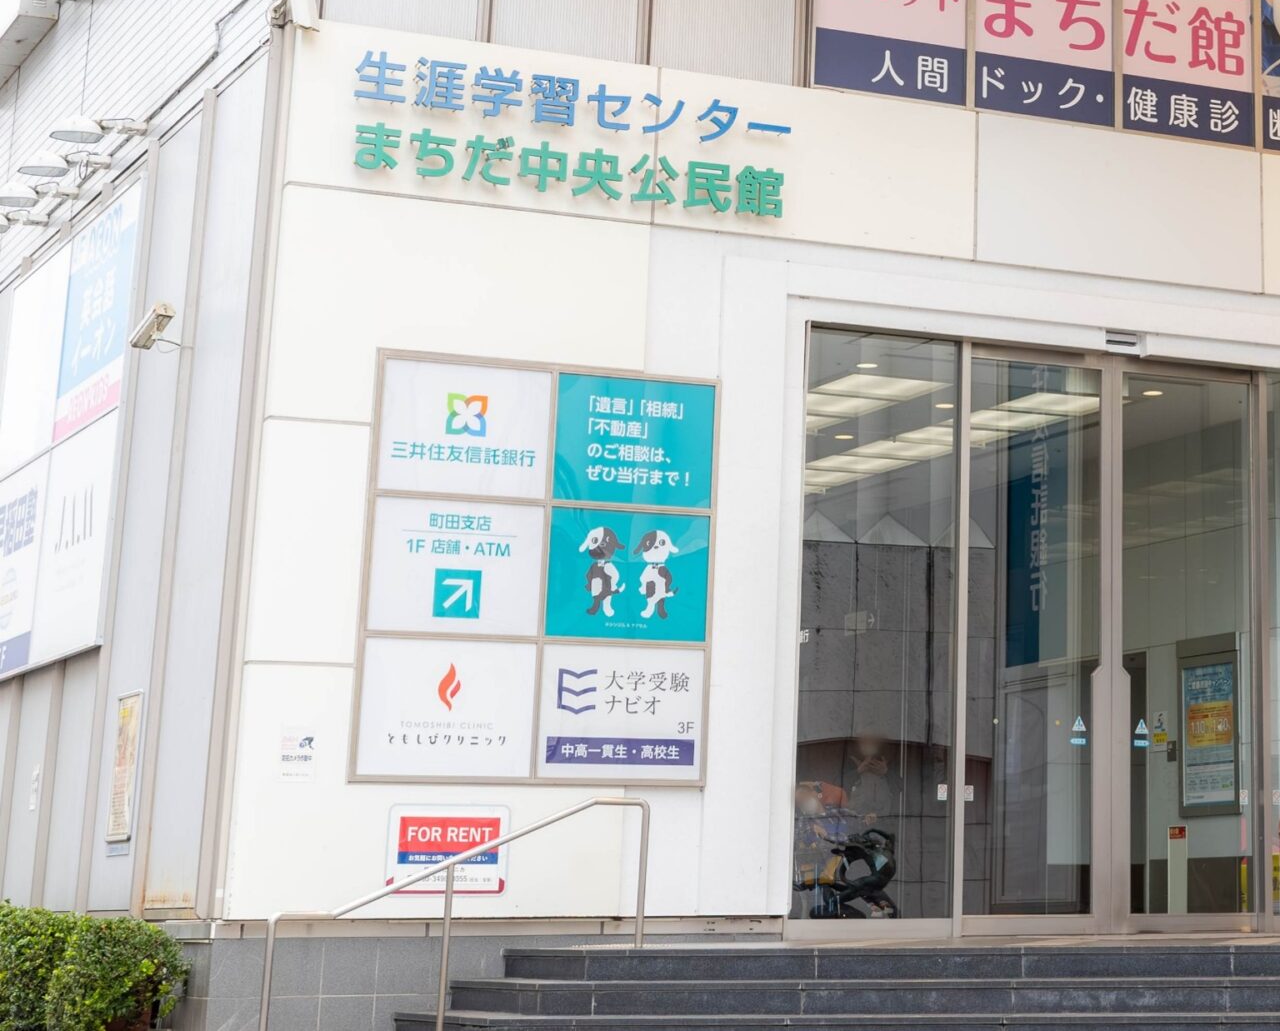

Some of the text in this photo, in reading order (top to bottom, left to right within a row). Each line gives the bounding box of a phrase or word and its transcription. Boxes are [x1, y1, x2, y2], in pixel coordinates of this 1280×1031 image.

[354, 49, 792, 144] 生涯学習センター
[353, 122, 784, 218] まちだ中央公民館
[587, 418, 648, 439] 「不動産」
[390, 441, 536, 468] 三井住友信託銀行
[587, 442, 673, 464] のご相談は、
[429, 513, 492, 532] 町田支店
[406, 539, 426, 554] 1F
[604, 671, 690, 693] 大学受験
[604, 695, 662, 715] ナビオ
[400, 720, 494, 730] TOMOSHIBI CLINIC
[677, 722, 695, 734] 3F
[387, 732, 507, 746] ともしびクリニック
[561, 743, 680, 760] 中高一貫生・高校生
[407, 826, 493, 843] FOR RENT
